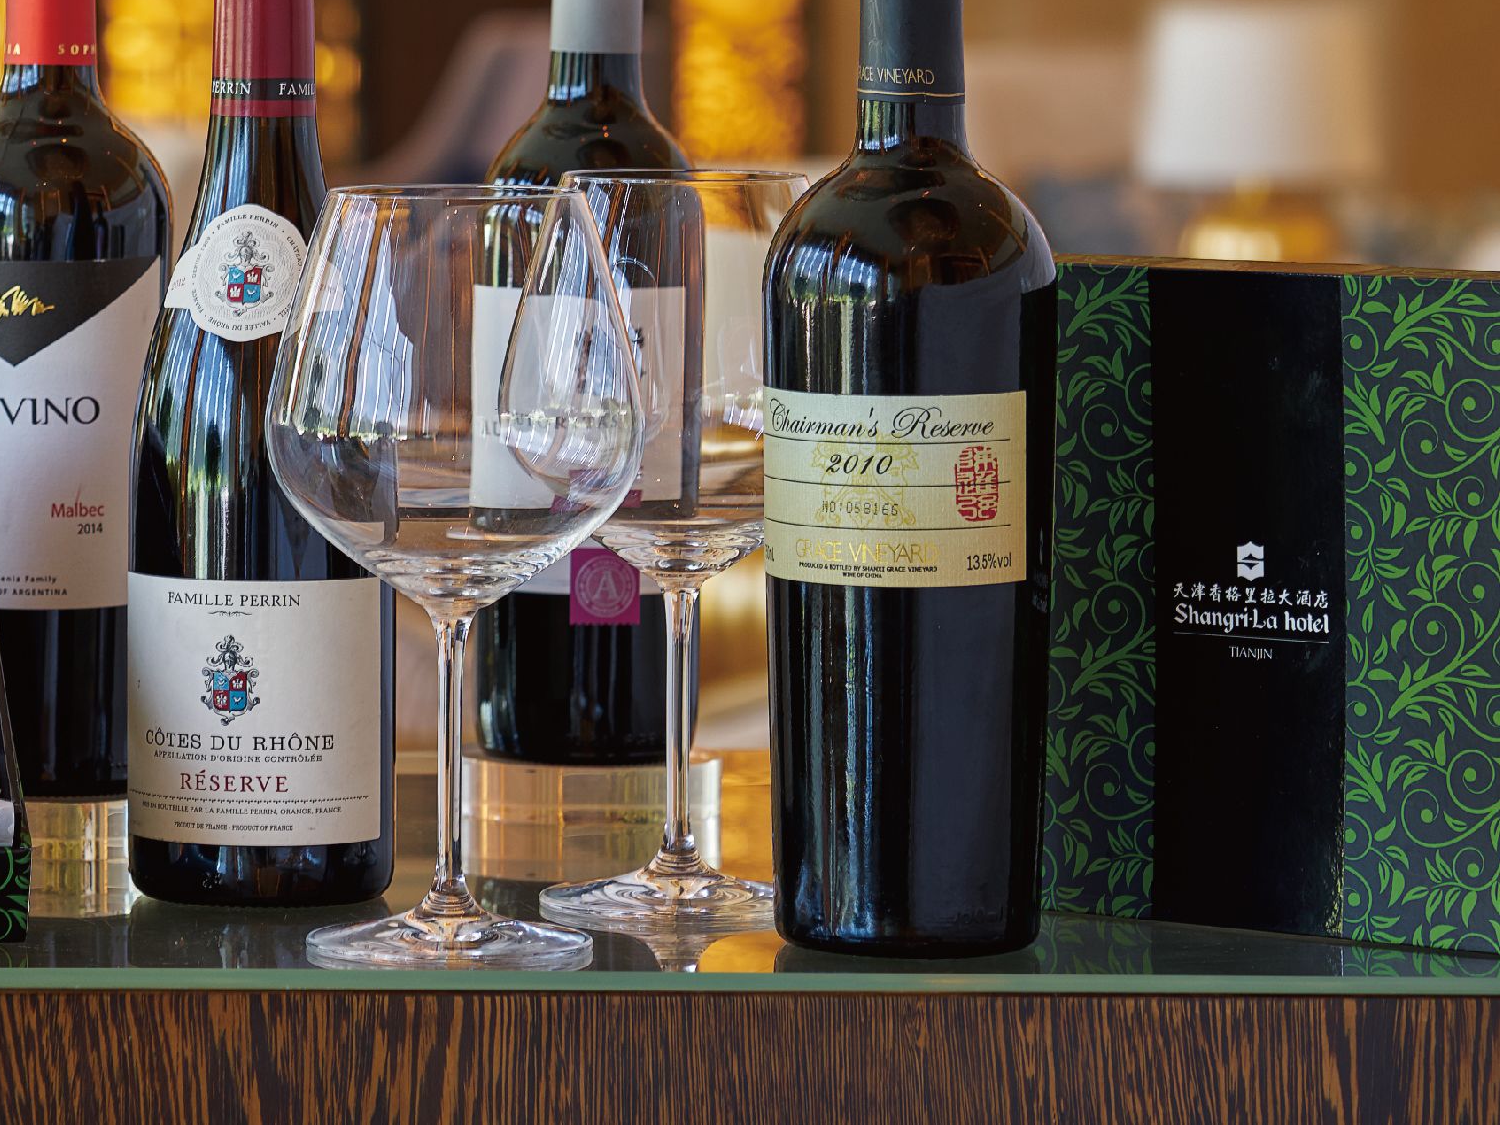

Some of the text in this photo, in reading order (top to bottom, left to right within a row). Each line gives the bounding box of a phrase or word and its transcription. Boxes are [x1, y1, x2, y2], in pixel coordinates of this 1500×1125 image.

[877, 67, 935, 85] VINEYARD
[770, 398, 994, 439] Chairman's Reserve
[826, 454, 893, 475] 2010
[51, 494, 105, 518] Malbec
[77, 523, 103, 535] 2014
[796, 539, 940, 564] GRACE VINEYARD
[887, 565, 905, 573] GRACE
[908, 565, 938, 573] VINEYARD
[167, 591, 301, 607] FAMILLE PERRIN
[1173, 581, 1329, 609] 天津香格里拉大酒店
[1284, 610, 1329, 634] hotel
[1229, 646, 1273, 660] TIANJIN
[145, 727, 334, 750] CÔTES DU RHÔNE
[154, 750, 322, 763] APPELLATION D'ORIGINE CONTRÔLÉE
[180, 770, 288, 792] RÉSERVE
